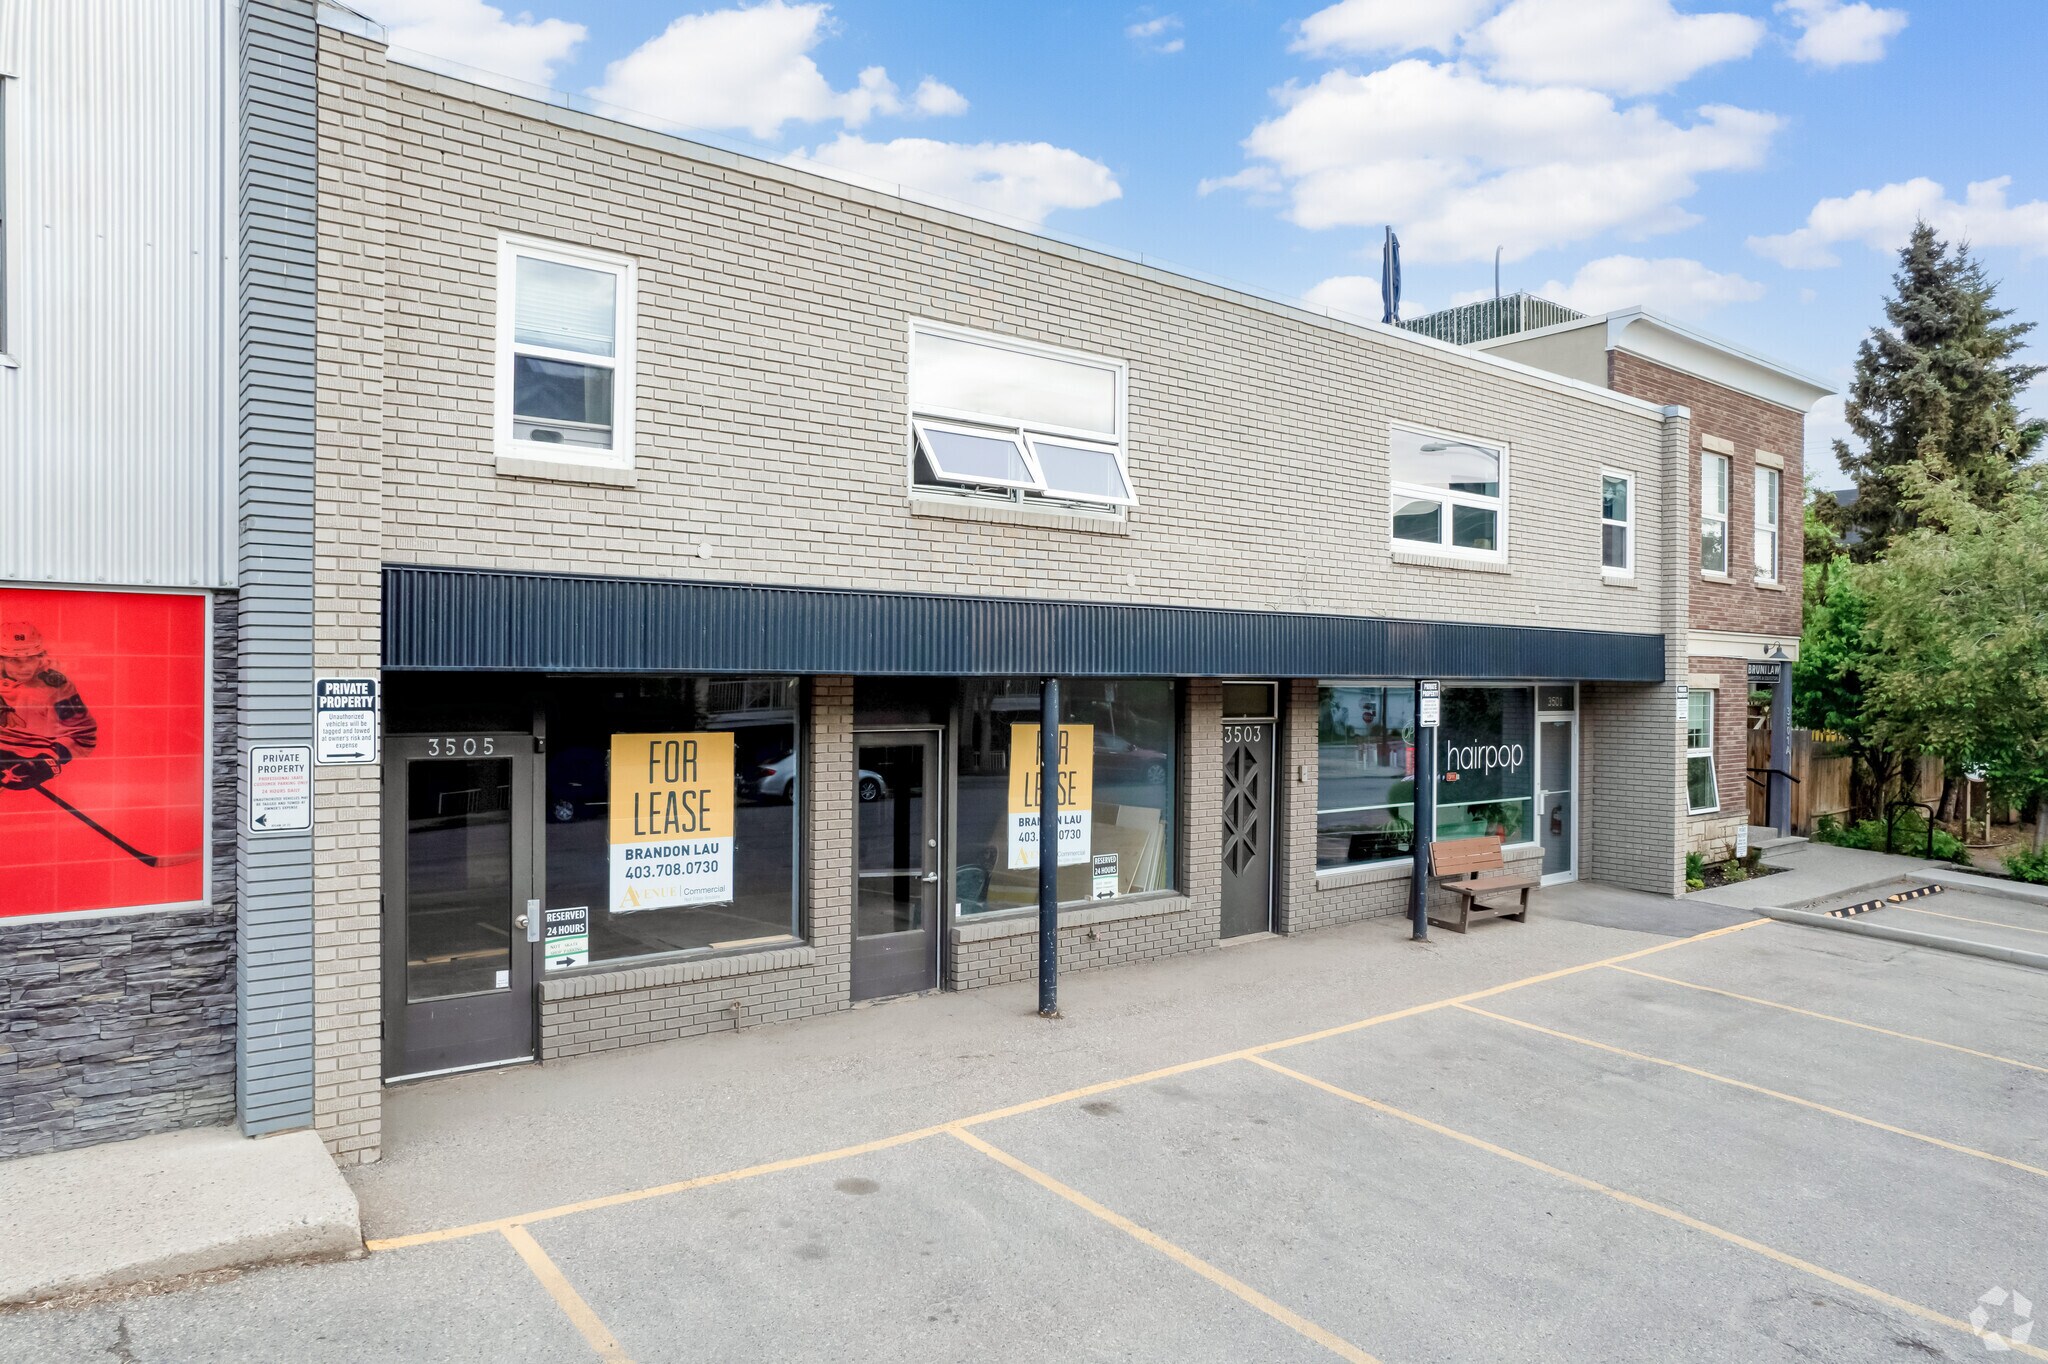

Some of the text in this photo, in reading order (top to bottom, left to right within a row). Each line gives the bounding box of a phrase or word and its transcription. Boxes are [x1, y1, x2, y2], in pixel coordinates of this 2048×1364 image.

[1748, 664, 1780, 674] BRUNI LAW
[326, 682, 368, 694] PRIVATE
[320, 696, 374, 708] PROPERTY
[1224, 726, 1261, 743] 3503
[428, 738, 494, 756] 3505
[1036, 730, 1068, 765] FR
[263, 754, 300, 762] PRIVATE
[649, 740, 698, 784] FOR
[1448, 738, 1524, 776] hairpop
[258, 764, 304, 773] PROPERTY
[1025, 772, 1076, 807] LESE
[634, 790, 711, 836] LEASE
[1065, 815, 1082, 824] LAU
[625, 843, 719, 860] BRANDON LAU
[1095, 856, 1116, 864] RESERVED
[625, 860, 718, 879] 403.708.0730
[1101, 866, 1116, 874] HOURS
[619, 884, 726, 908] AVENUE Commercial
[547, 910, 585, 922] RESERVED
[547, 923, 585, 936] 24 HOURS
